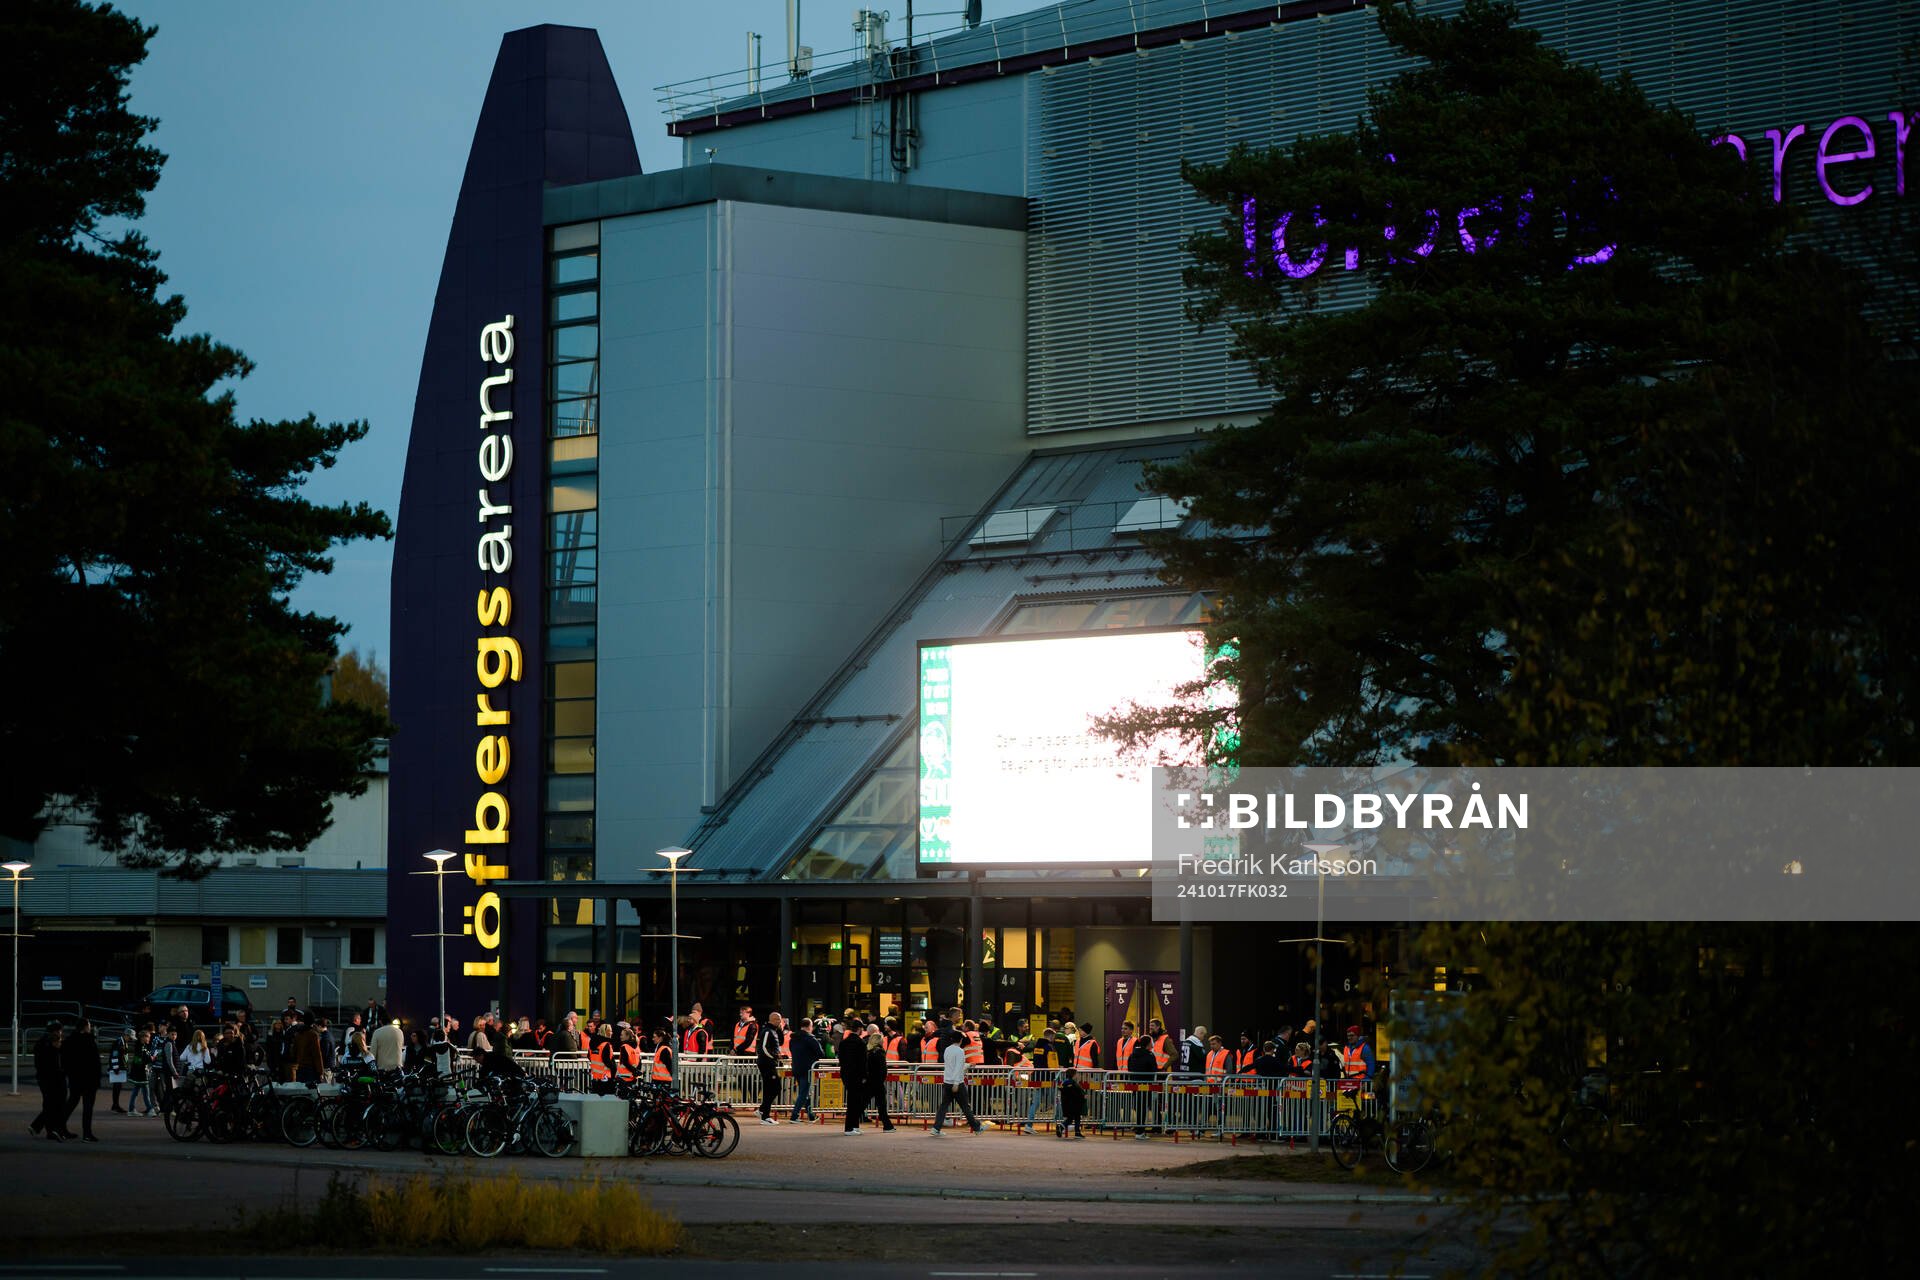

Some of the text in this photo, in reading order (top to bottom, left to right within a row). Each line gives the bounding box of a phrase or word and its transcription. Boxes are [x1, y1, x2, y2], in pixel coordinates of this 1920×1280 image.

[877, 971, 885, 984] 2
[1001, 973, 1008, 987] 4
[1343, 978, 1351, 992] 6
